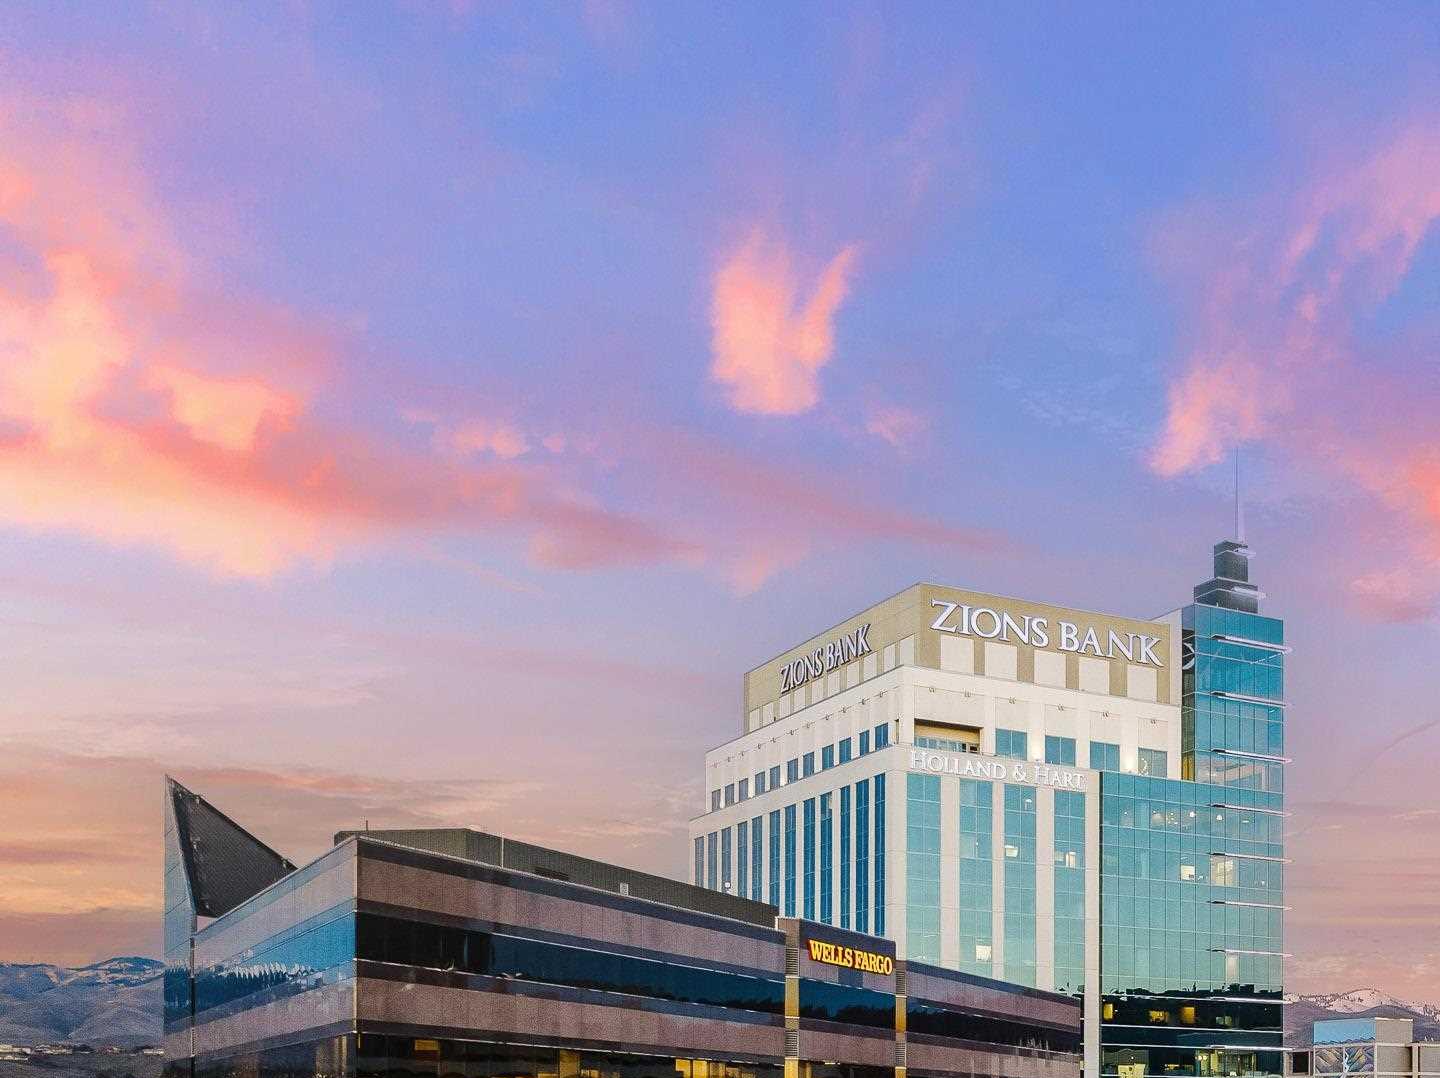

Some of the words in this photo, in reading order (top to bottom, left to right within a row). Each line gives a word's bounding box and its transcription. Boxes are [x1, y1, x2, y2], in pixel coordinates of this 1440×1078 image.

[781, 647, 824, 694] ZIONS
[826, 623, 872, 672] BANK
[929, 598, 1049, 648] ZIONS
[1057, 621, 1164, 667] BANK
[911, 750, 1007, 780] HOLLAND
[1014, 764, 1028, 782] &
[1035, 761, 1085, 789] HART
[808, 939, 853, 968] WELLS
[854, 949, 893, 975] FARGO
